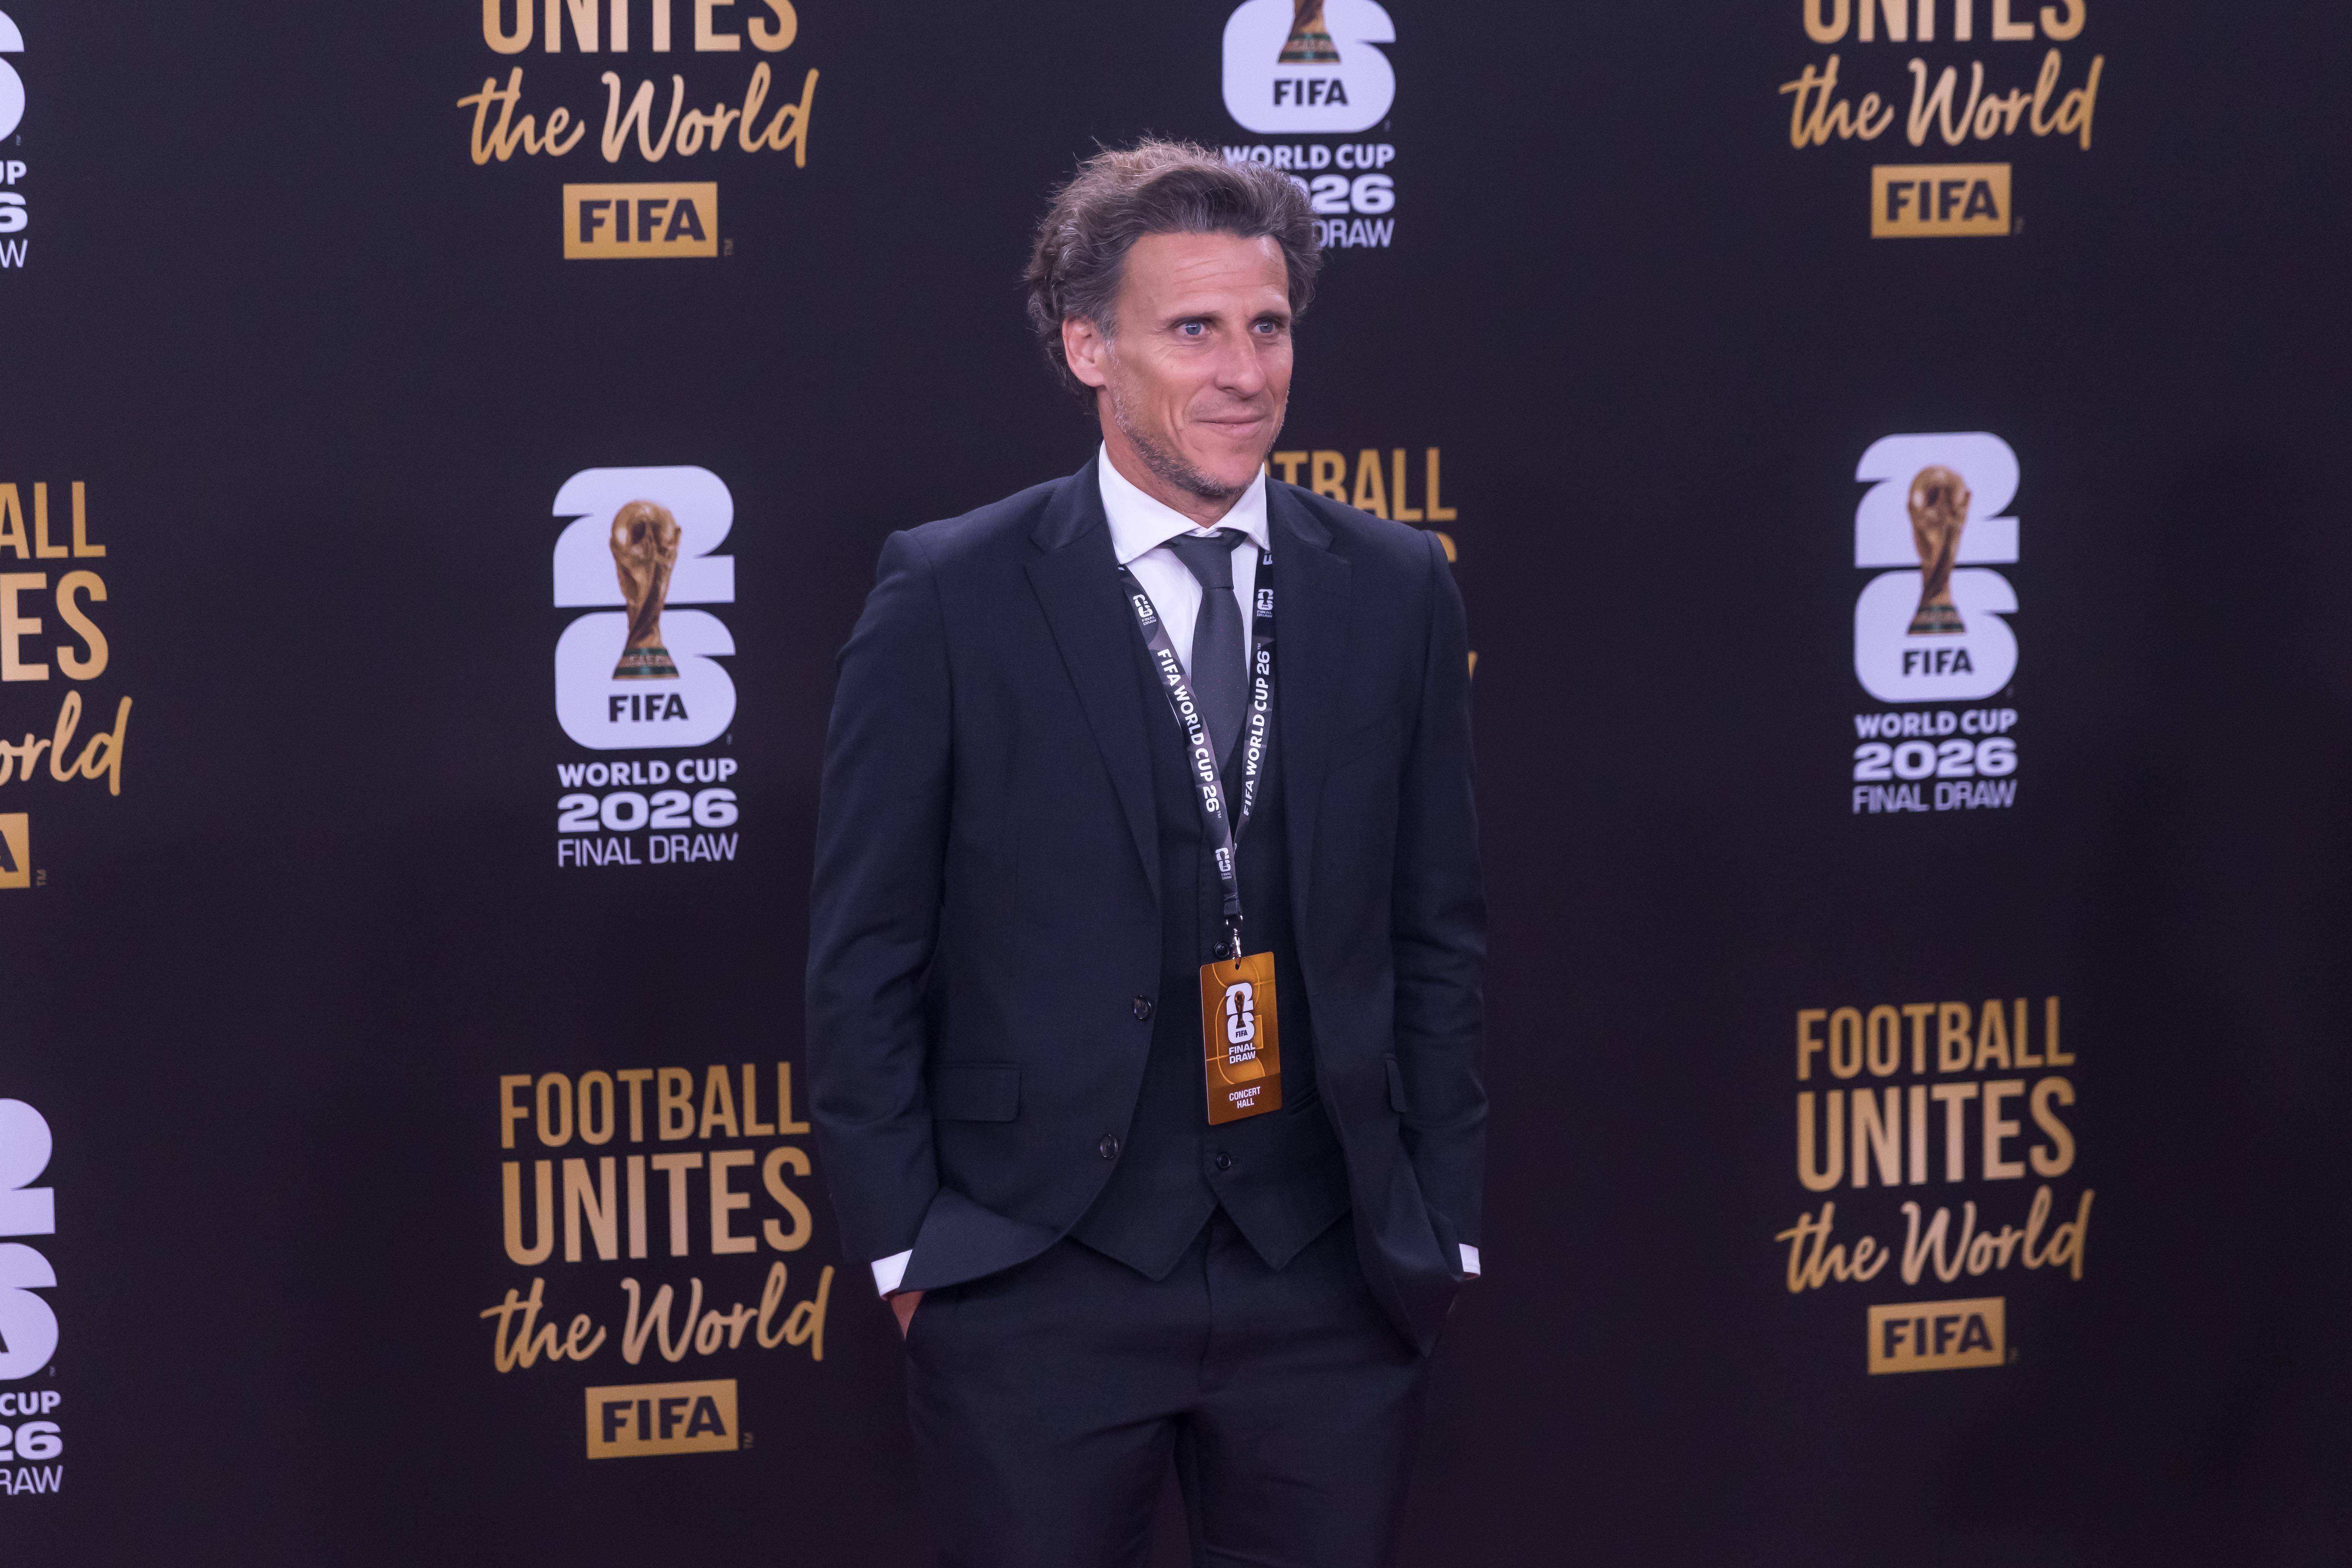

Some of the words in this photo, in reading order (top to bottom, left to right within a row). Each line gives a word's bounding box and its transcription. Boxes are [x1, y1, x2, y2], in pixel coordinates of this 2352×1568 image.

[1274, 79, 1348, 106] FIFA
[1779, 54, 1893, 148] the
[1907, 49, 2104, 149] World
[457, 67, 585, 165] the
[601, 62, 819, 167] World
[1335, 144, 1395, 169] CUP
[1289, 173, 1395, 214] 26
[1886, 179, 2000, 223] FIFA
[579, 198, 707, 244] FIFA
[1903, 648, 1973, 676] FIFA
[609, 693, 688, 722] FIFA
[1254, 678, 1268, 711] CUP
[1157, 648, 1181, 687] FIFA
[1174, 684, 1204, 745] WORLD
[1195, 748, 1214, 782] CUP
[1855, 711, 1957, 738] WORLD
[1960, 709, 2018, 735] CUP
[1246, 714, 1265, 775] WORLD
[1853, 737, 2018, 781] 2026
[557, 760, 670, 788] WORLD
[676, 758, 738, 783] CUP
[557, 788, 738, 833] 2026
[1243, 780, 1254, 816] FIFA
[1853, 783, 1930, 814] FINAL
[1934, 779, 2017, 811] DRAW
[558, 837, 642, 867] FINAL
[649, 832, 739, 864] DRAW
[1229, 1043, 1256, 1055] FINAL
[1235, 1030, 1248, 1038] FIFA
[1797, 996, 2075, 1081] FOOTBALL
[1230, 1051, 1256, 1064] DRAW
[500, 1061, 810, 1149] FOOTBALL
[1229, 1086, 1261, 1101] CONCERT
[1237, 1098, 1255, 1108] HALL
[1797, 1077, 2075, 1192] UNITES
[502, 1146, 812, 1266] UNITES
[1775, 1201, 1889, 1293] the
[1901, 1185, 2094, 1285] World
[480, 1277, 606, 1373] the
[620, 1261, 834, 1365] World
[1883, 1313, 1995, 1359] FIFA
[0, 1391, 61, 1417] CUP
[602, 1396, 727, 1443] FIFA
[0, 1465, 63, 1495] RAW
